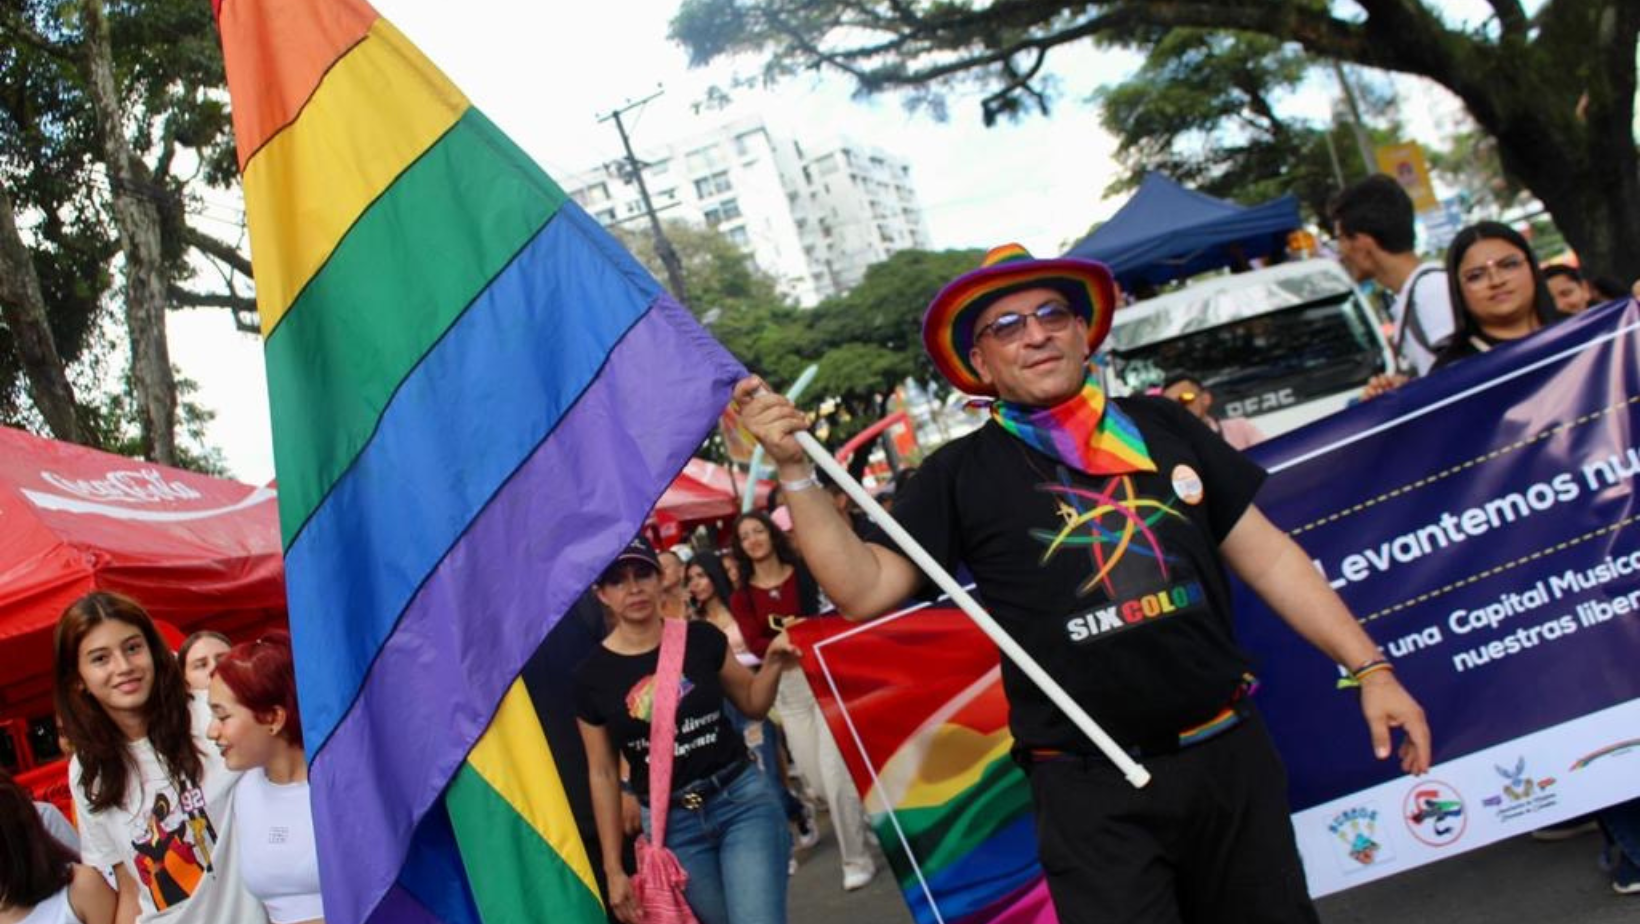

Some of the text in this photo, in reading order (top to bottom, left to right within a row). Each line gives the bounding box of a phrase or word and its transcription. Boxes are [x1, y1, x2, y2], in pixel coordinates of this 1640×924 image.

[1313, 446, 1640, 590] Levantemos nu
[1387, 625, 1443, 658] una
[1448, 580, 1550, 635] Capital
[1452, 614, 1578, 672] nuestras
[180, 787, 205, 812] 92
